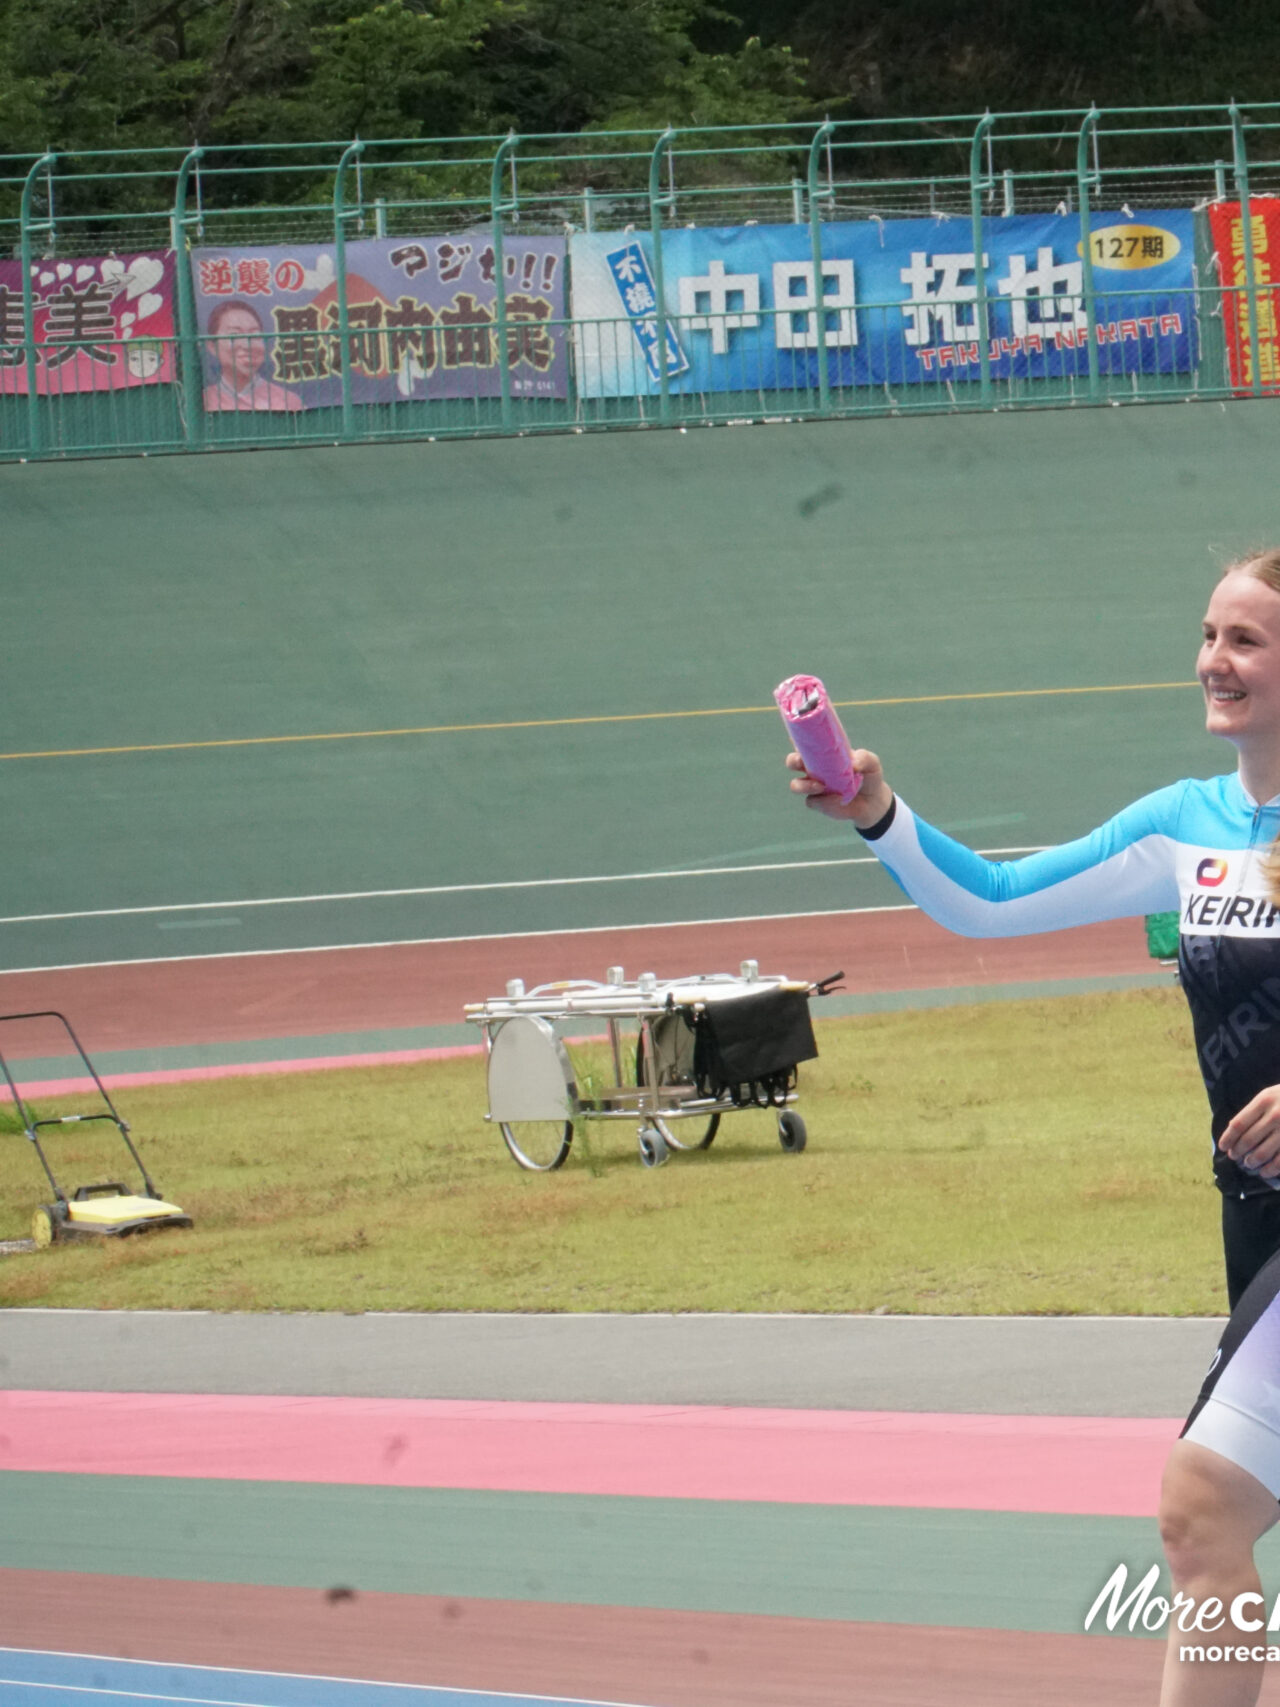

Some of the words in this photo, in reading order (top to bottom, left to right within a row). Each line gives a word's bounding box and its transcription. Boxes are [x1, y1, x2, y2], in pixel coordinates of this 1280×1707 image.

[1094, 234, 1165, 260] 127期
[199, 256, 305, 297] 逆襲の
[678, 259, 859, 356] 中田
[900, 246, 1090, 346] 拓也
